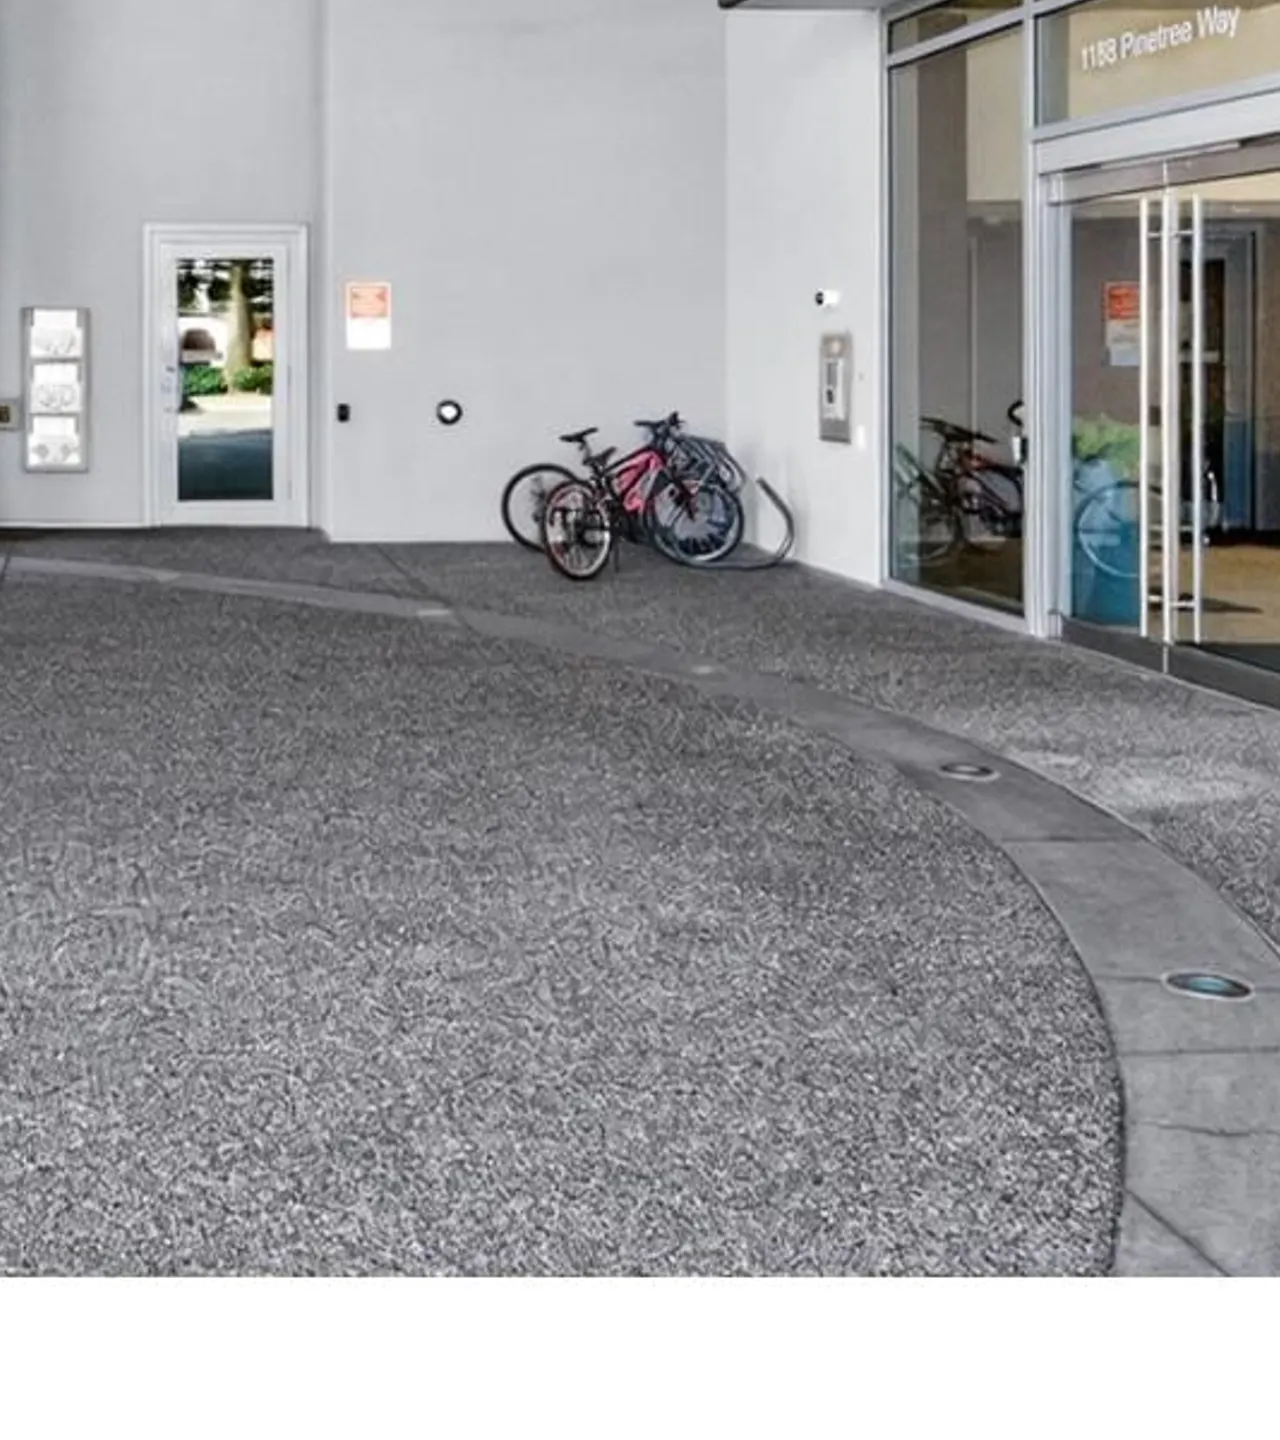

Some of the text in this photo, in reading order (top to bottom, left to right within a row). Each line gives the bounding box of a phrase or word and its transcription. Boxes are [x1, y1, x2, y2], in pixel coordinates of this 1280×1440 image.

[1081, 6, 1240, 71] 1188 Pinetree Way
